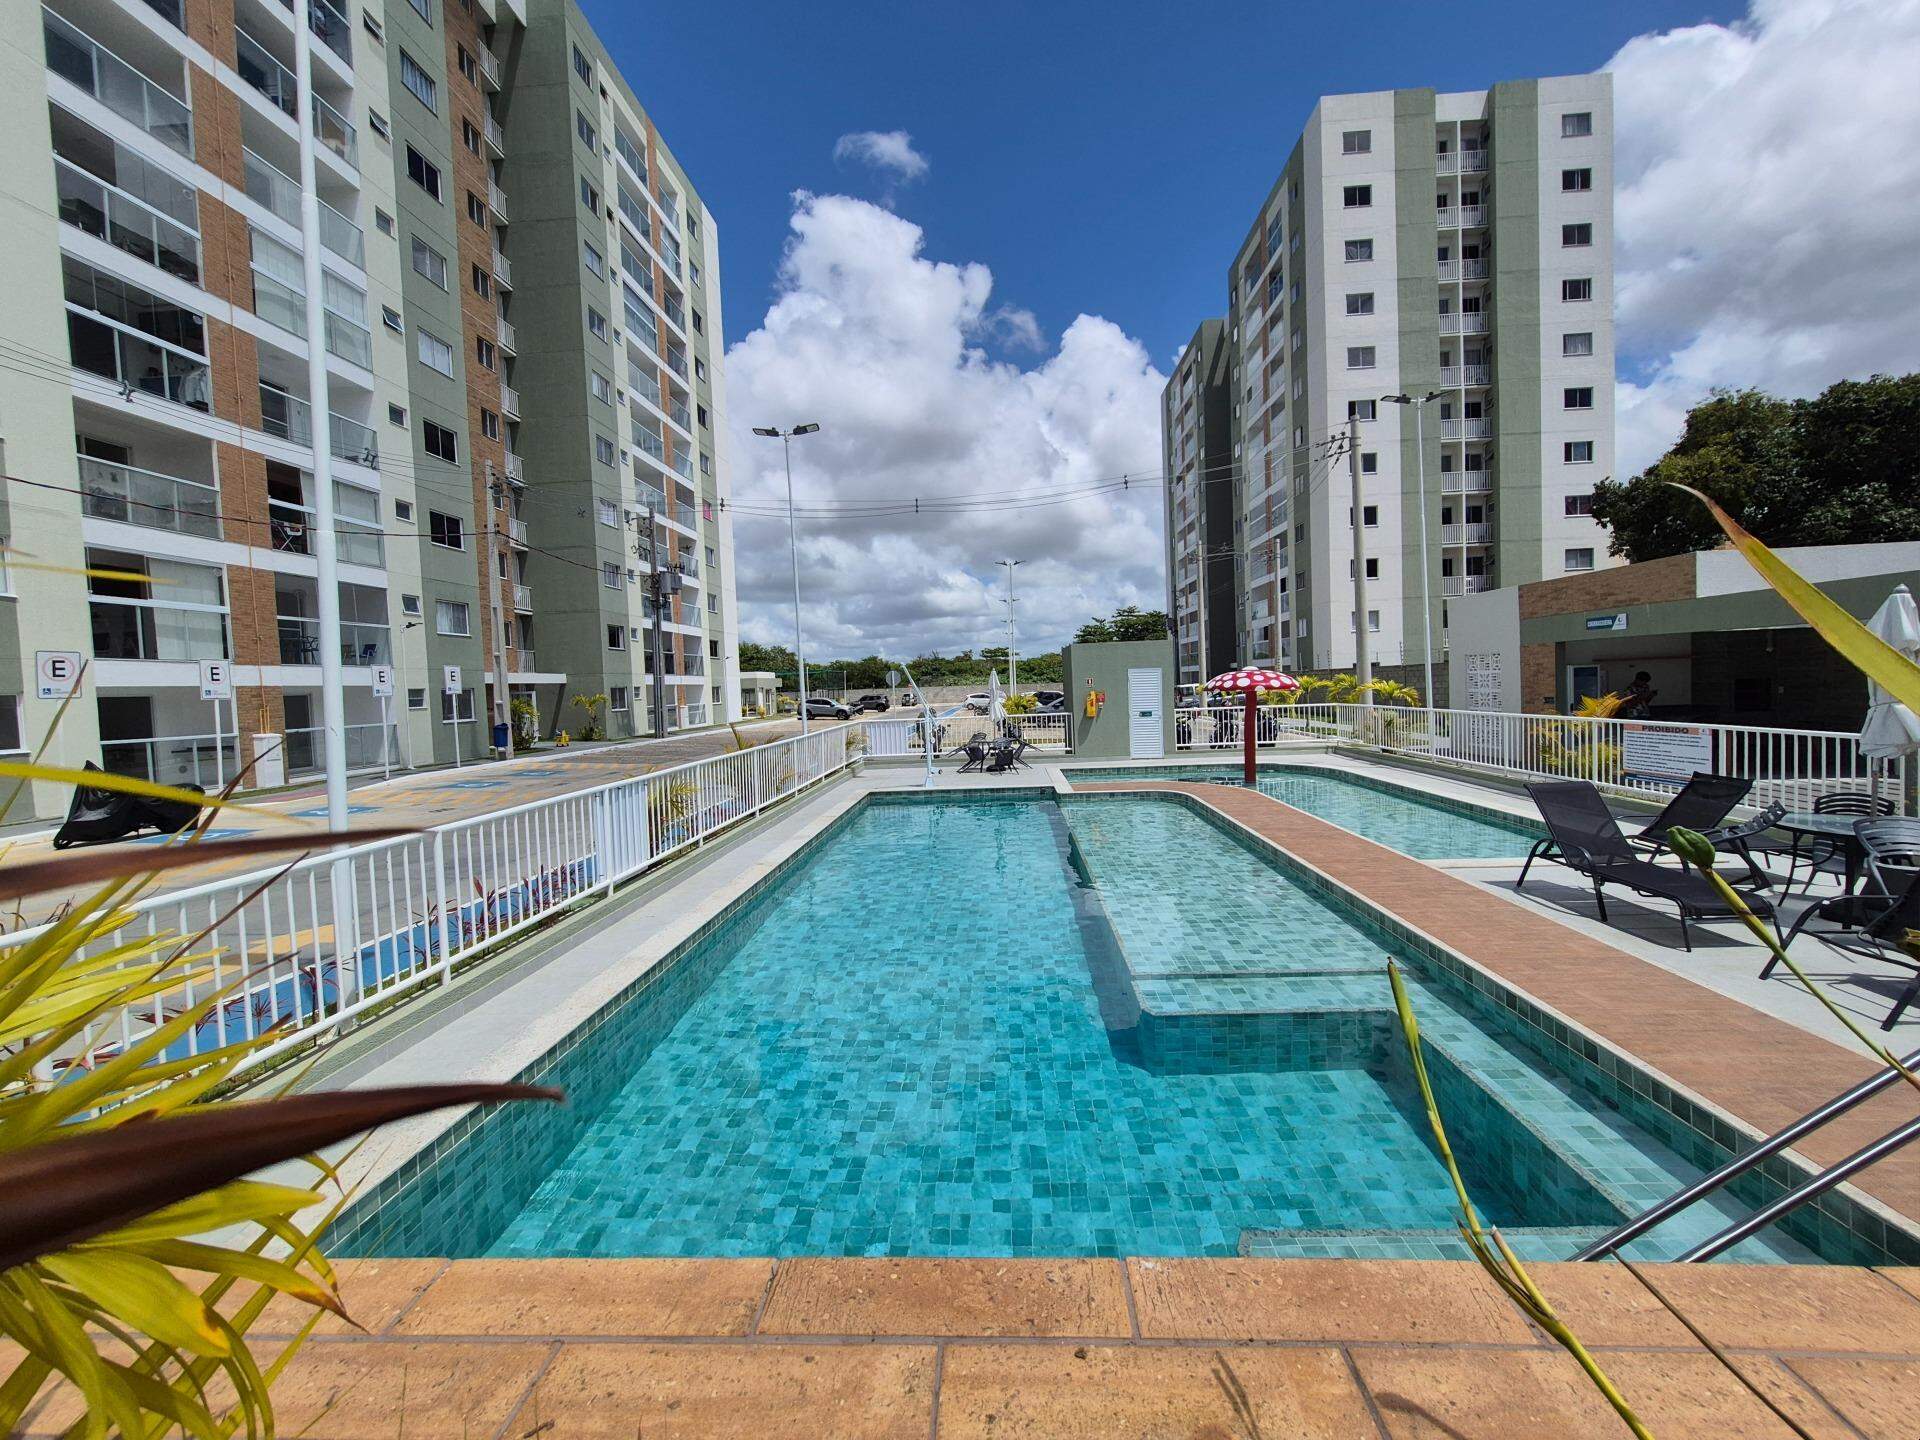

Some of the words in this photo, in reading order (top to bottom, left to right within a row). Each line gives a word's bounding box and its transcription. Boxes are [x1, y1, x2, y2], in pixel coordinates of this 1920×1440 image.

[52, 660, 66, 678] E
[211, 667, 221, 682] E
[379, 671, 386, 683] E
[450, 671, 457, 682] E
[1642, 725, 1690, 734] PROIBIDO
